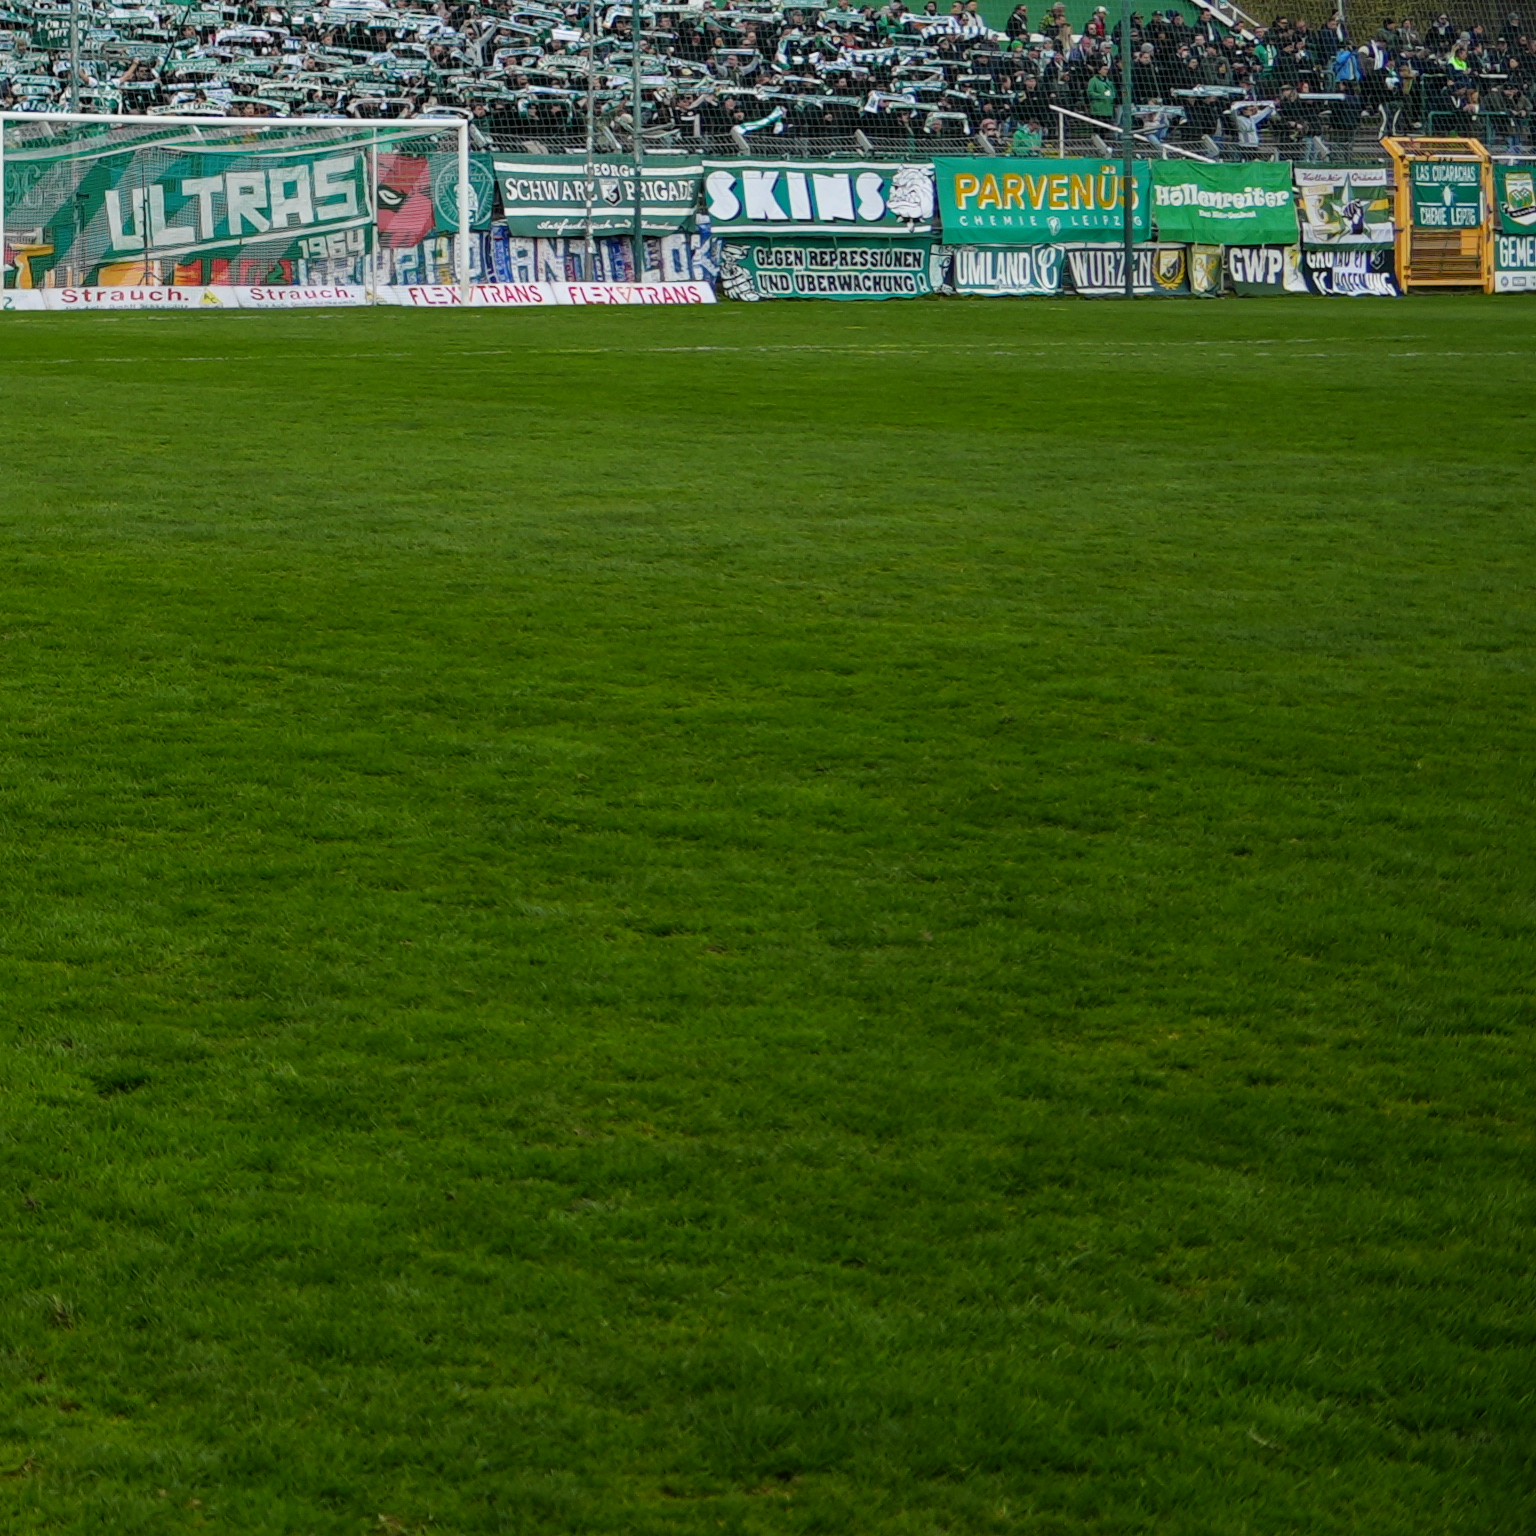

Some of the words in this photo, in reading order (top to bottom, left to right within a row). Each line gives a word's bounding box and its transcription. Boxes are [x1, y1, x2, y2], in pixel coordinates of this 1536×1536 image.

[505, 177, 599, 201] SCHWARZ
[705, 170, 886, 222] SKINS
[1154, 183, 1290, 209] Höllenreiter
[105, 155, 359, 252] ULTRAS
[959, 214, 1038, 227] CHEMIE
[1071, 215, 1143, 228] LEIPZG
[297, 230, 365, 260] 1964
[754, 247, 805, 268] GEGEN
[808, 248, 925, 271] REPRESSIONEN
[956, 250, 1030, 286] UMLAND
[1229, 247, 1283, 284] GWP
[251, 287, 356, 301] Strauch.
[759, 271, 794, 293] UND
[61, 288, 190, 303] Strauch.
